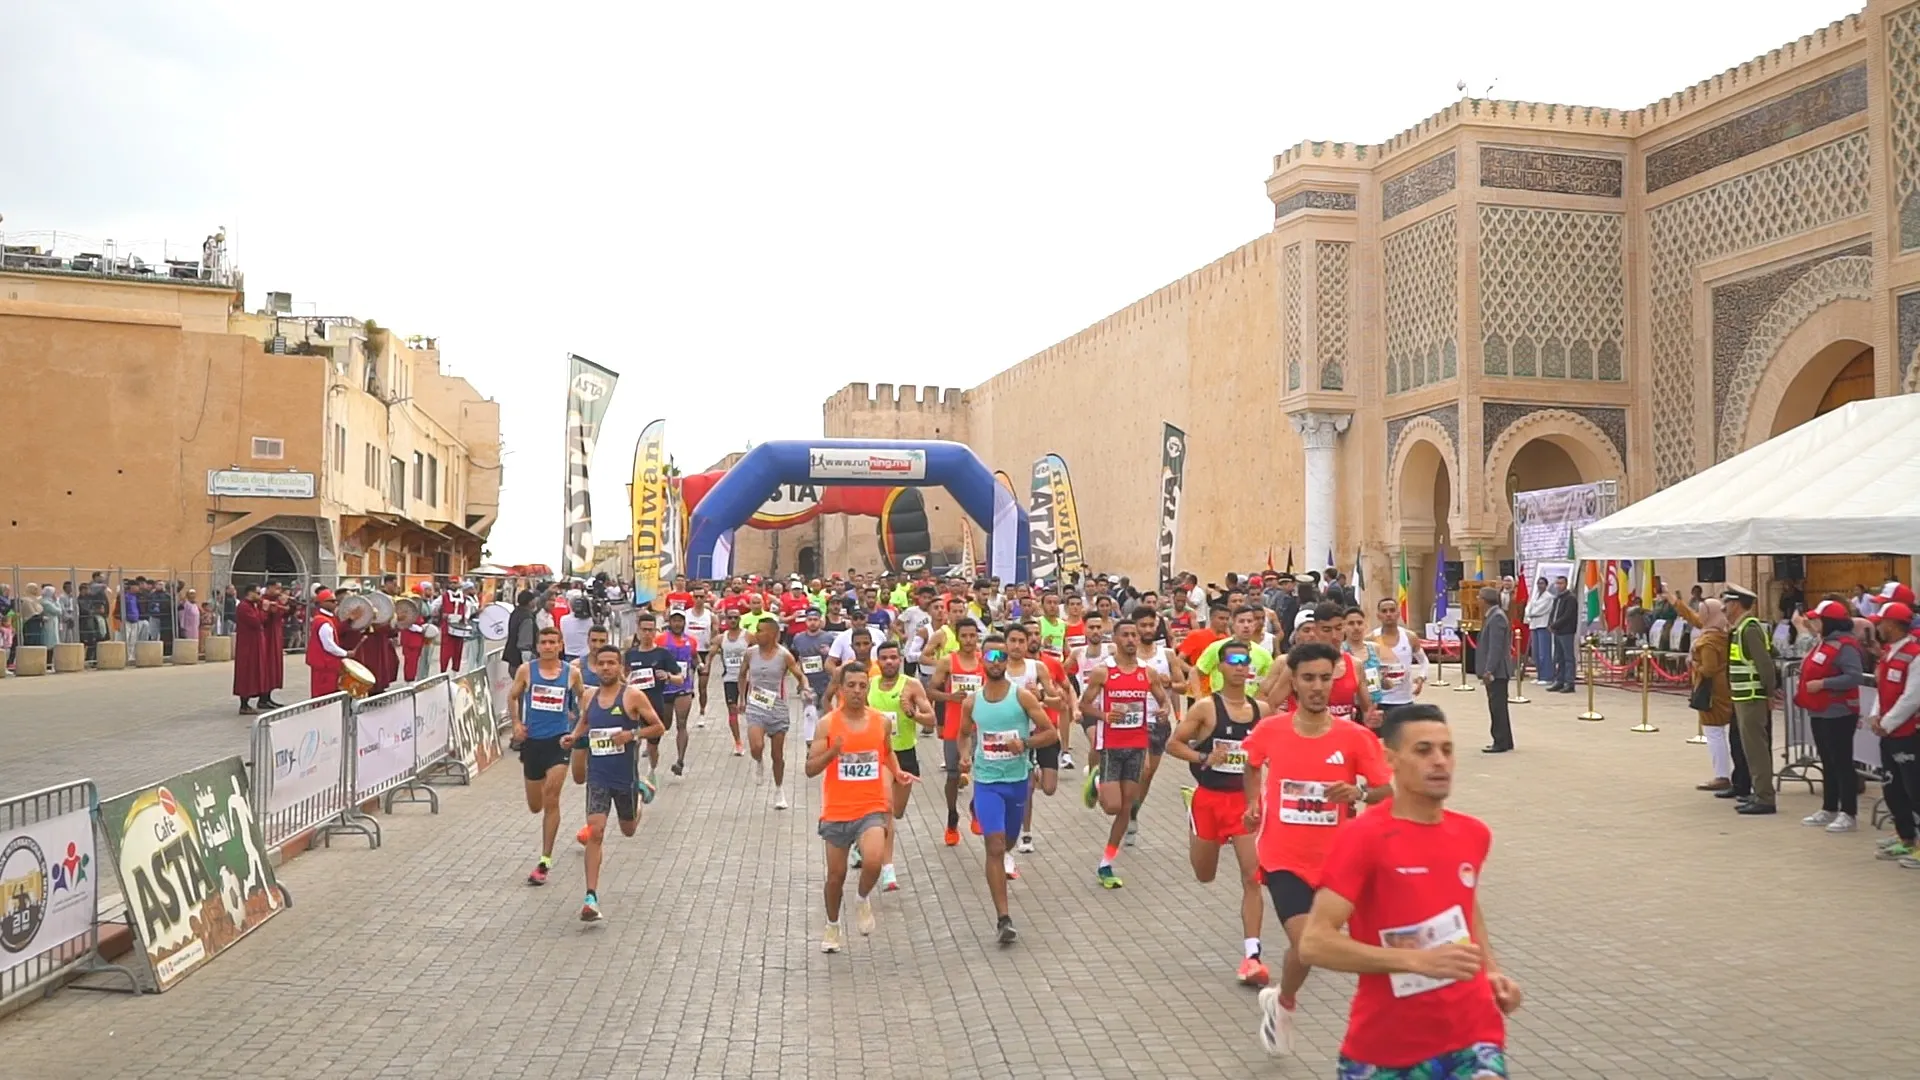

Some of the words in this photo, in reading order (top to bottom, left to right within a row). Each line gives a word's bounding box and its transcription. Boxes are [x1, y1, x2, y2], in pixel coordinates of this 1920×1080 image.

[826, 457, 911, 469] www.running.ma
[637, 440, 660, 554] Diwan
[904, 558, 926, 567] ASTA
[843, 764, 872, 777] 1422
[154, 815, 177, 842] Café
[132, 831, 215, 946] ASTA
